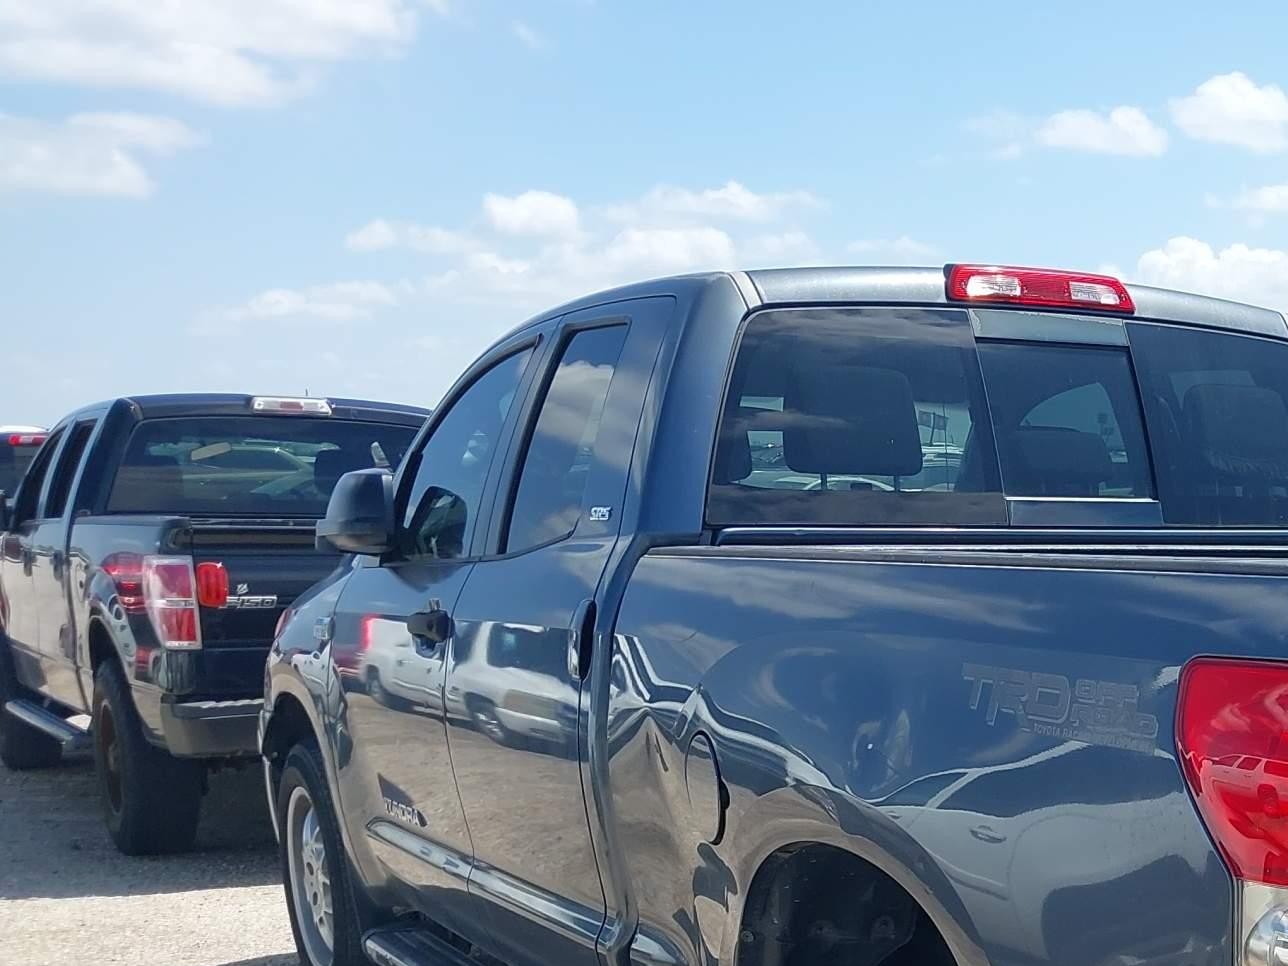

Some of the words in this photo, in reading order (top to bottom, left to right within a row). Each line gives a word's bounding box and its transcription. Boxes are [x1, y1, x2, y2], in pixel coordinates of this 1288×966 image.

[961, 662, 1071, 732] TRD
[1074, 678, 1140, 708] OFF
[1033, 722, 1061, 737] TOYOTA
[1069, 703, 1159, 739] ROAD
[382, 796, 421, 827] TUNDRA
